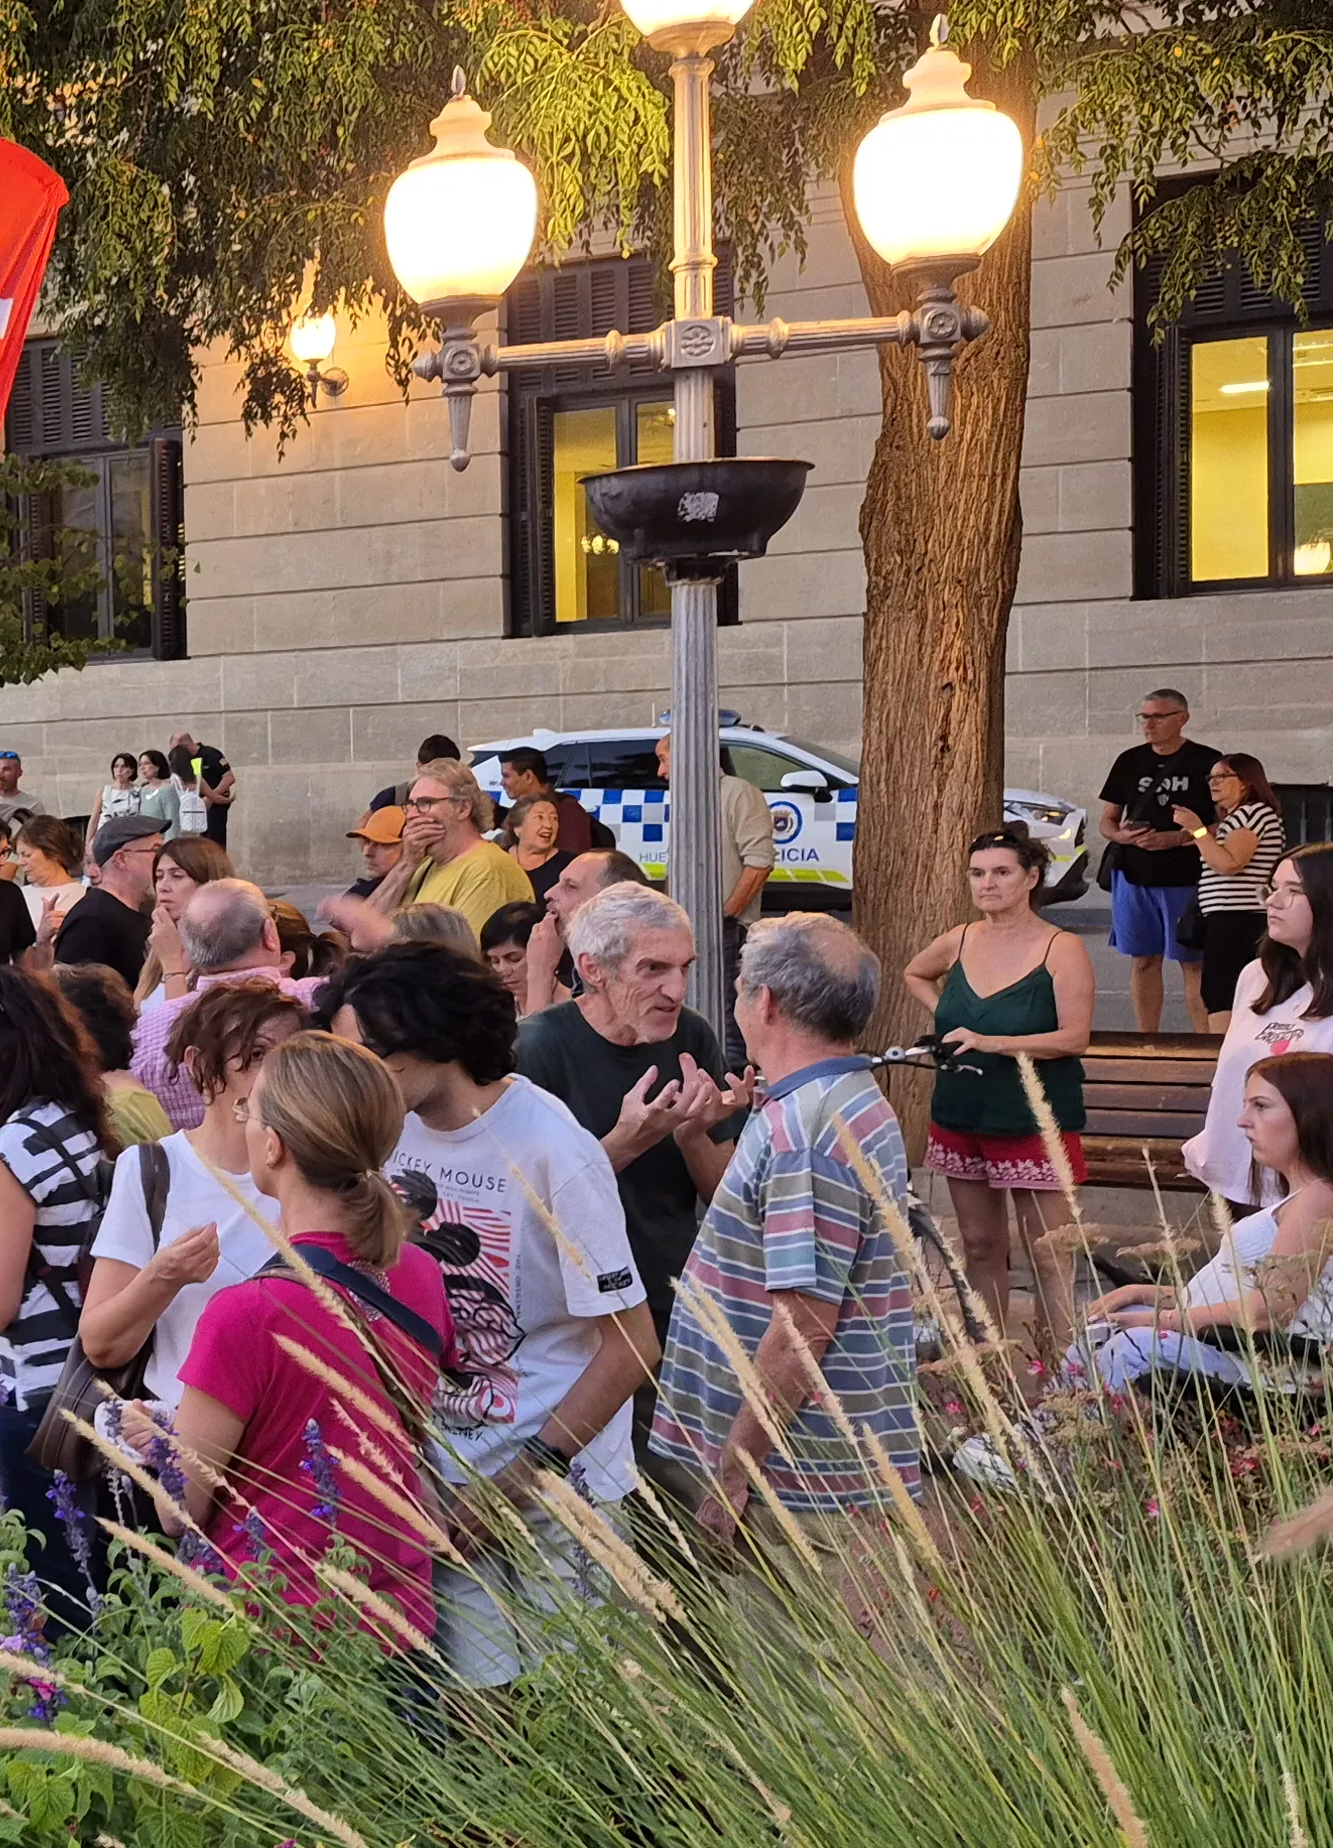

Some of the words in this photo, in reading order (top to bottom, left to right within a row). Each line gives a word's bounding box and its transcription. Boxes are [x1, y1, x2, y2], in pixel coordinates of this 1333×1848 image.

[639, 852, 667, 863] HUE
[780, 847, 820, 863] ICIA
[392, 1151, 433, 1174] ICKEY
[439, 1166, 507, 1193] MOUSE
